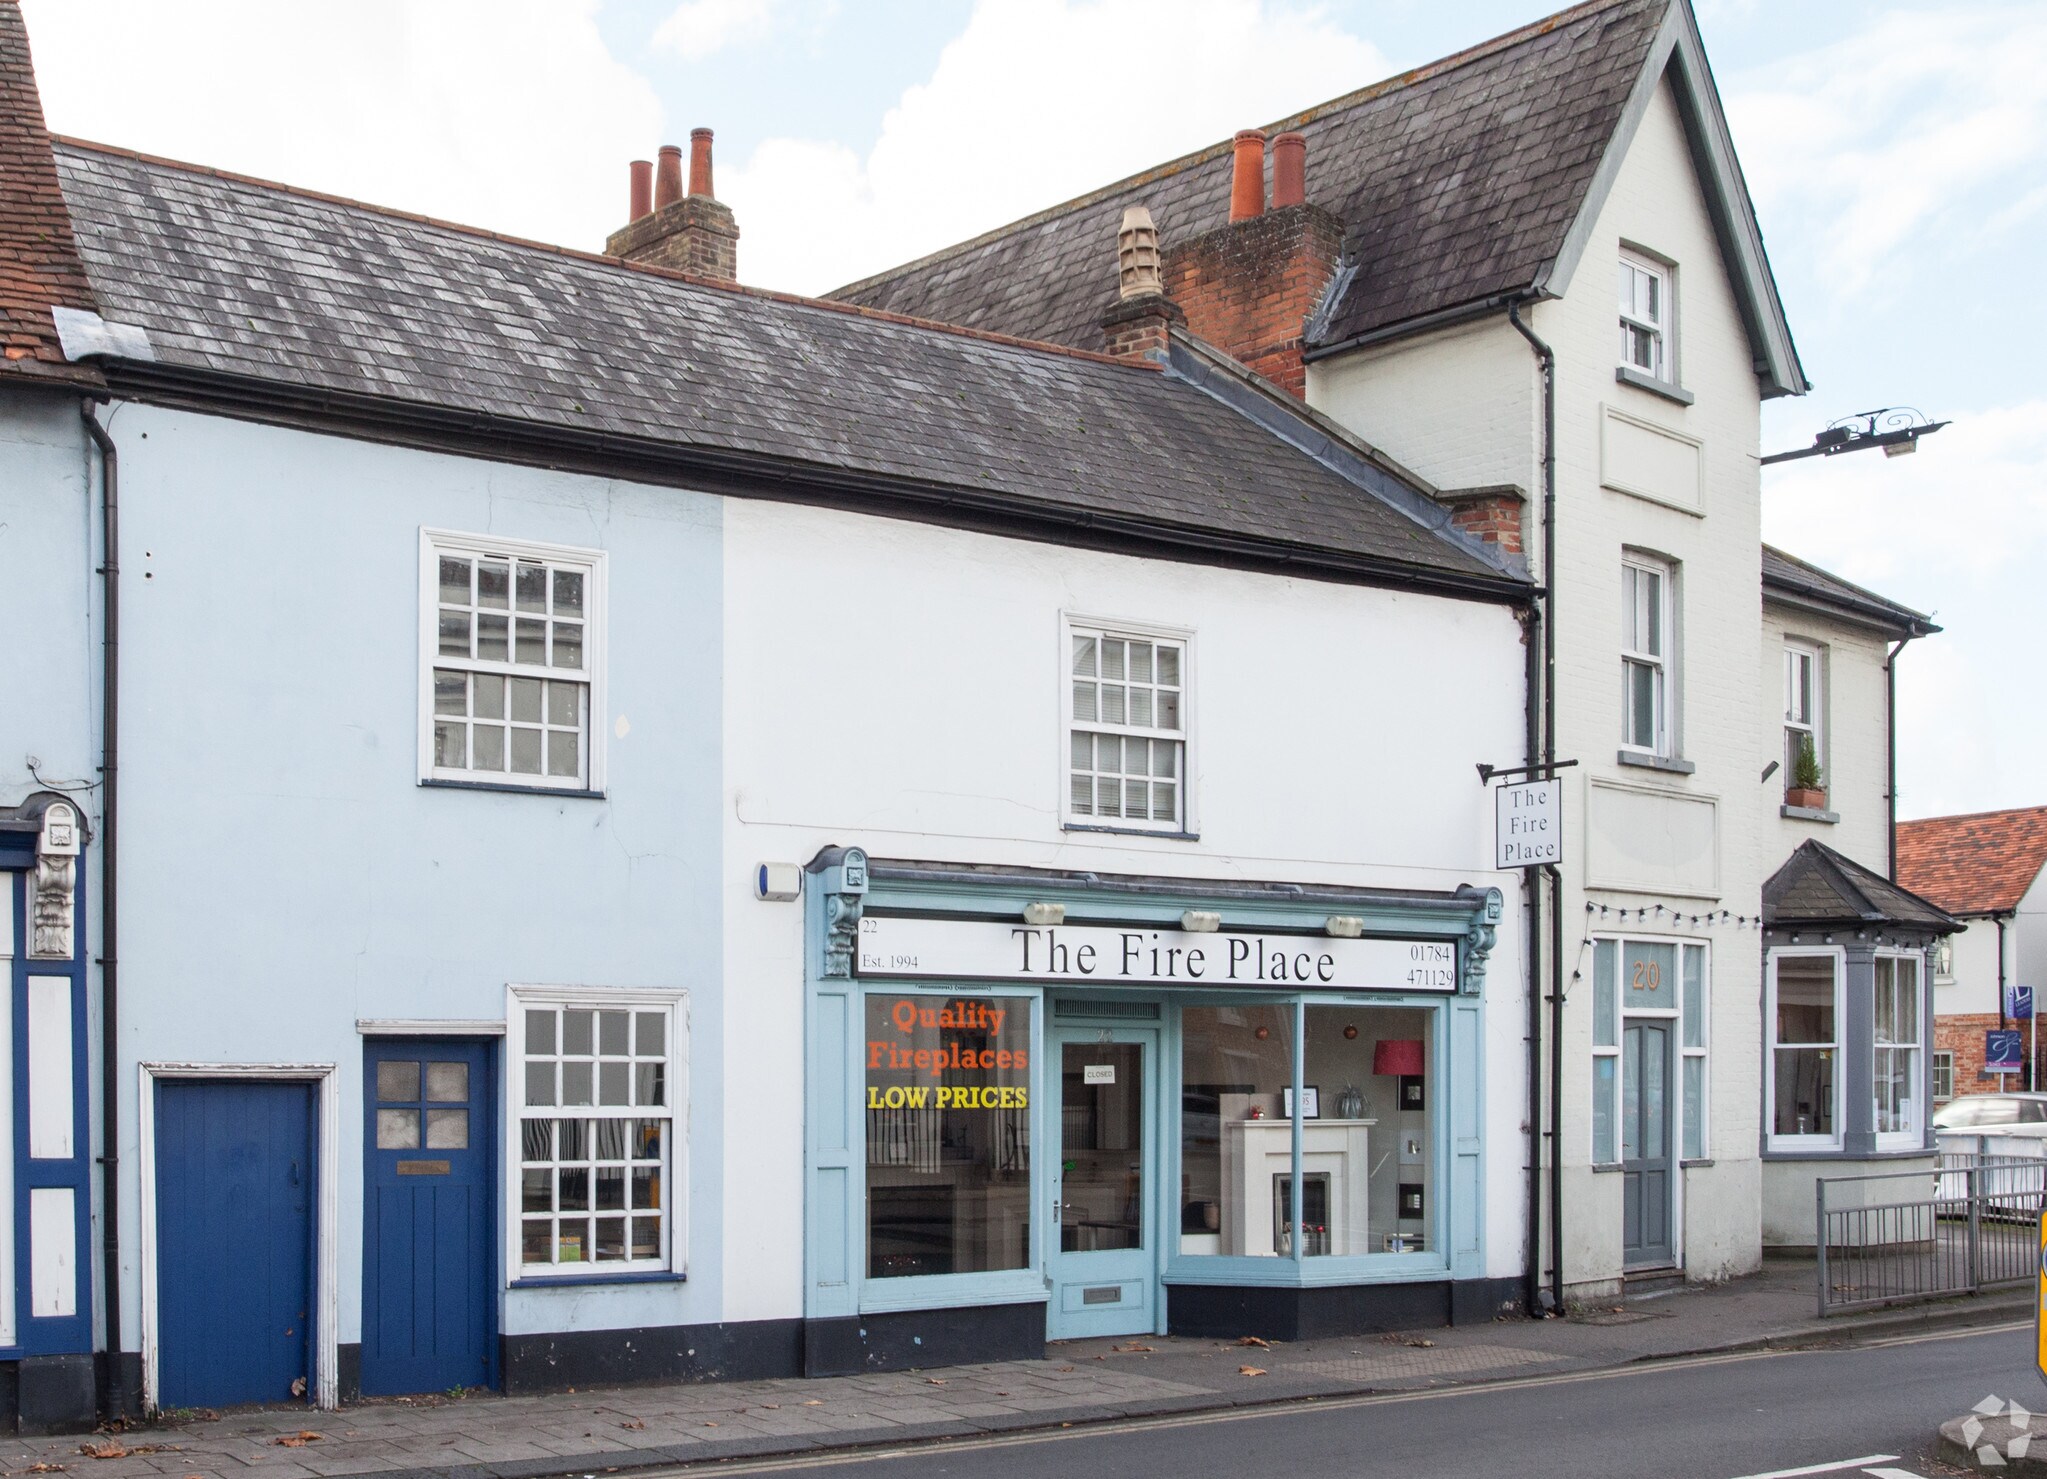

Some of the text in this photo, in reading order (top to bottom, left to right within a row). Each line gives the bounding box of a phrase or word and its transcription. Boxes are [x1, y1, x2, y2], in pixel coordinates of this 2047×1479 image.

[1510, 789, 1547, 808] The
[1510, 815, 1548, 835] Fire
[1504, 842, 1555, 861] Place
[862, 920, 878, 933] 22
[862, 954, 919, 969] Est. 1994
[1011, 928, 1335, 982] The Fire Place
[1410, 944, 1450, 962] 01784
[1407, 969, 1454, 986] 471129
[1632, 959, 1660, 991] 20
[891, 1000, 1006, 1036] Quality
[867, 1041, 1028, 1077] Fireplaces
[1087, 1070, 1113, 1078] CLOSED
[867, 1086, 1028, 1109] LOW PRICES
